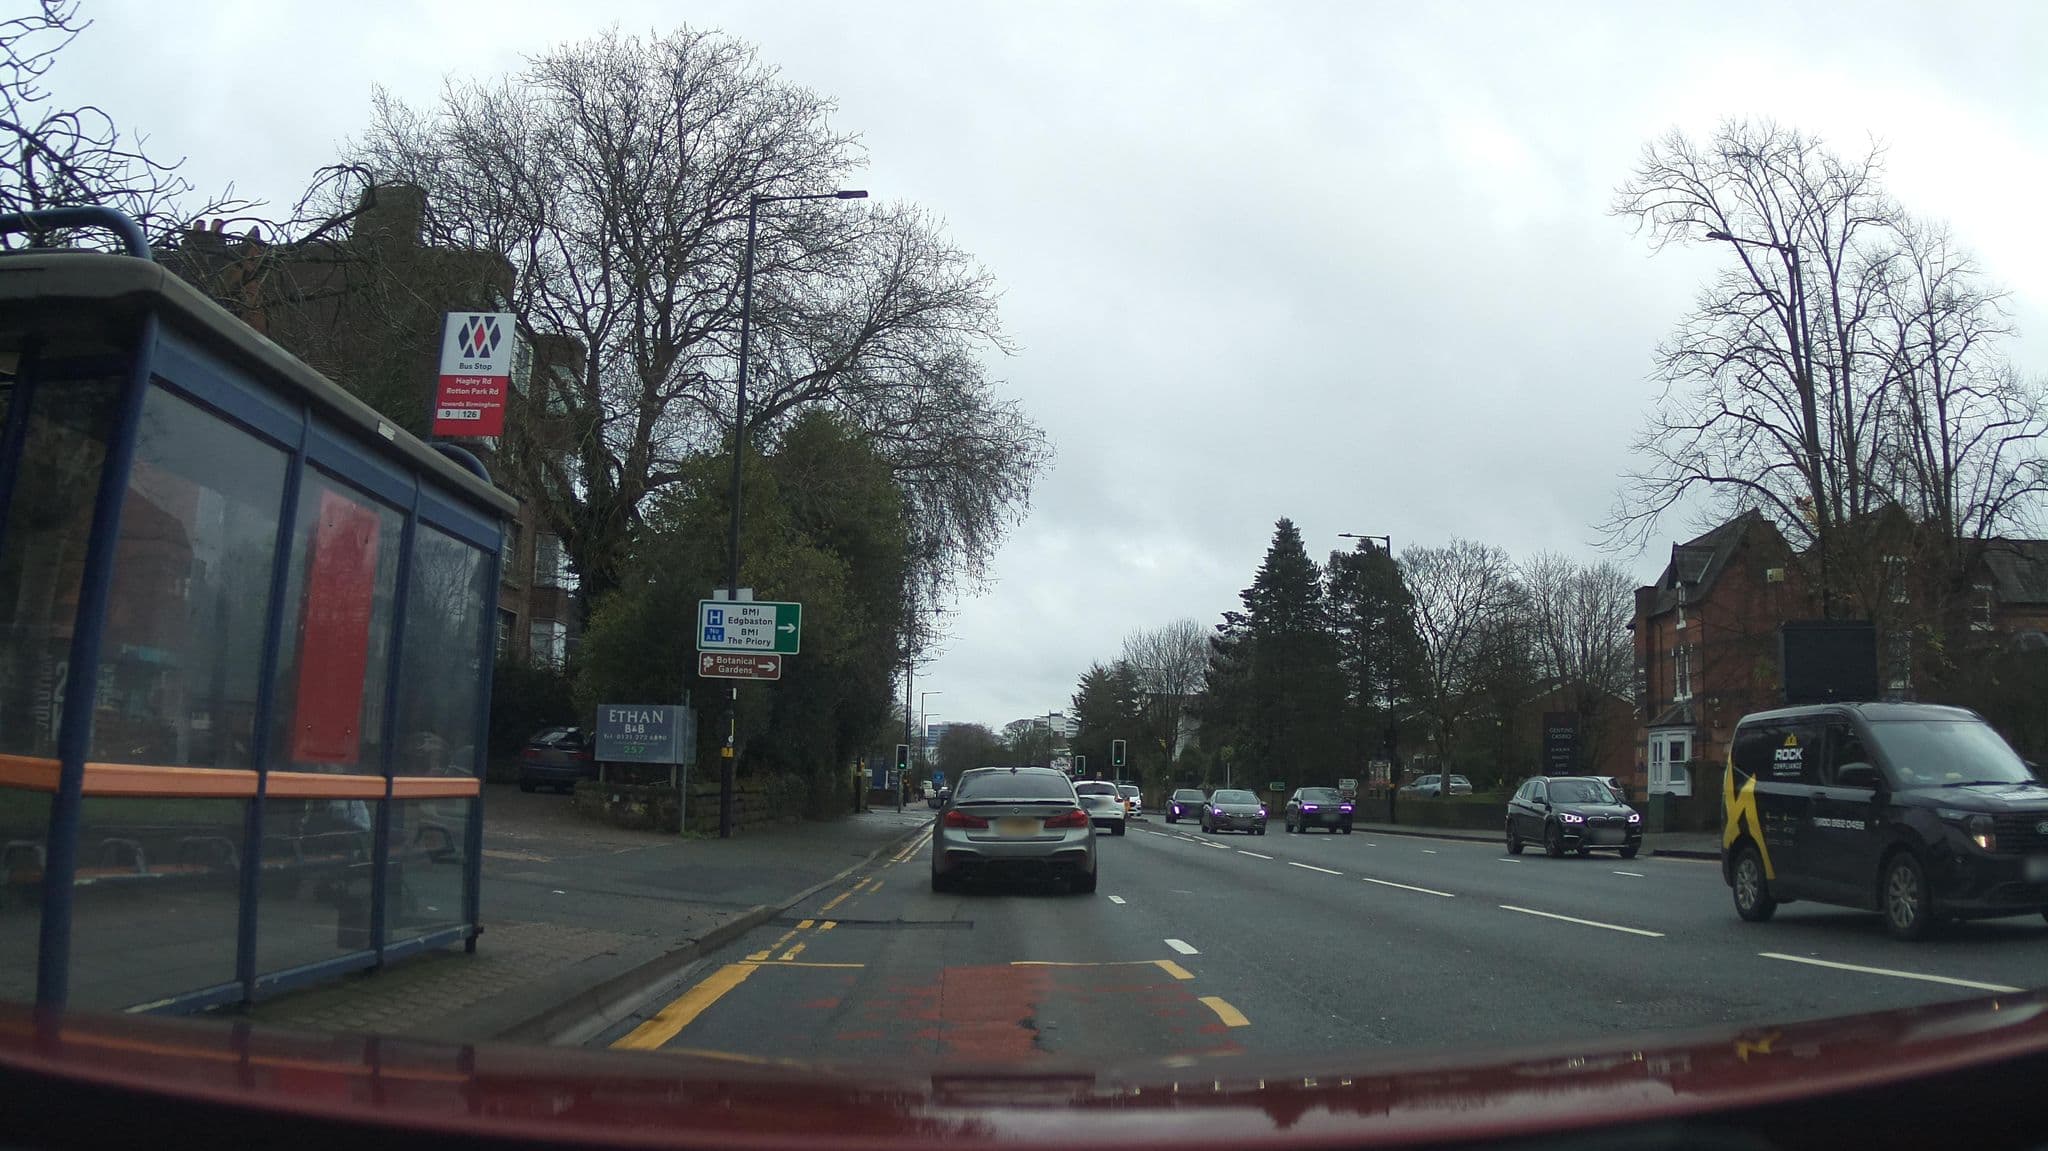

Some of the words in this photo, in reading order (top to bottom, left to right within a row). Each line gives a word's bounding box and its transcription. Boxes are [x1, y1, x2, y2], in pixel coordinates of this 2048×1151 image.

[474, 363, 493, 371] Stop
[742, 608, 759, 616] BMI
[728, 617, 773, 625] Edgbaston
[728, 637, 743, 645] The
[745, 638, 771, 646] Priory
[716, 656, 756, 666] Botanical
[718, 666, 753, 674] Gardens
[609, 710, 664, 724] ETHAN
[625, 724, 645, 733] B&B
[1775, 748, 1803, 760] ROCK
[1773, 762, 1802, 770] COMPLIANCE
